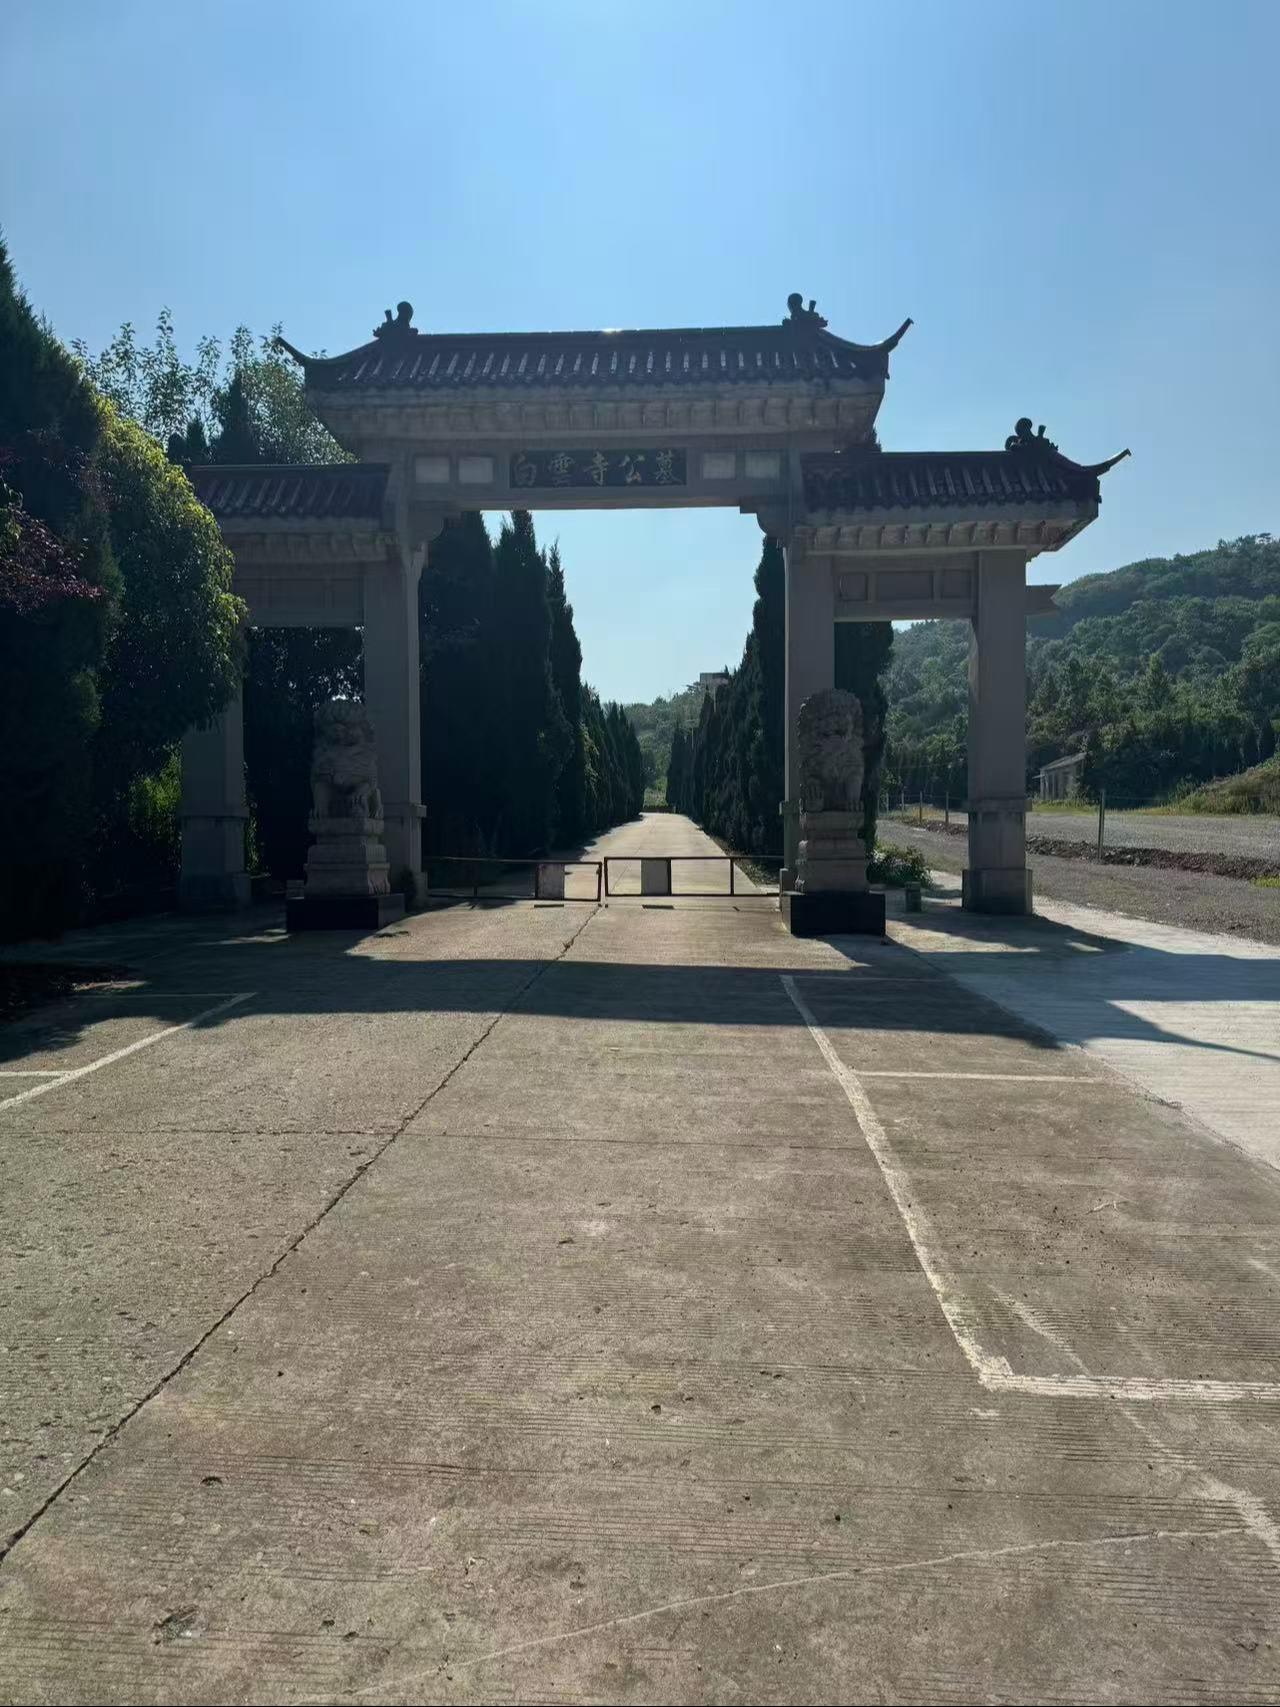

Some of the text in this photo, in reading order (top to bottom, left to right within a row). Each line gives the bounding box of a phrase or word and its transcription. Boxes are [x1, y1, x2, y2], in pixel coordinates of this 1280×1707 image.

[513, 449, 680, 487] 白雲寺公墓
